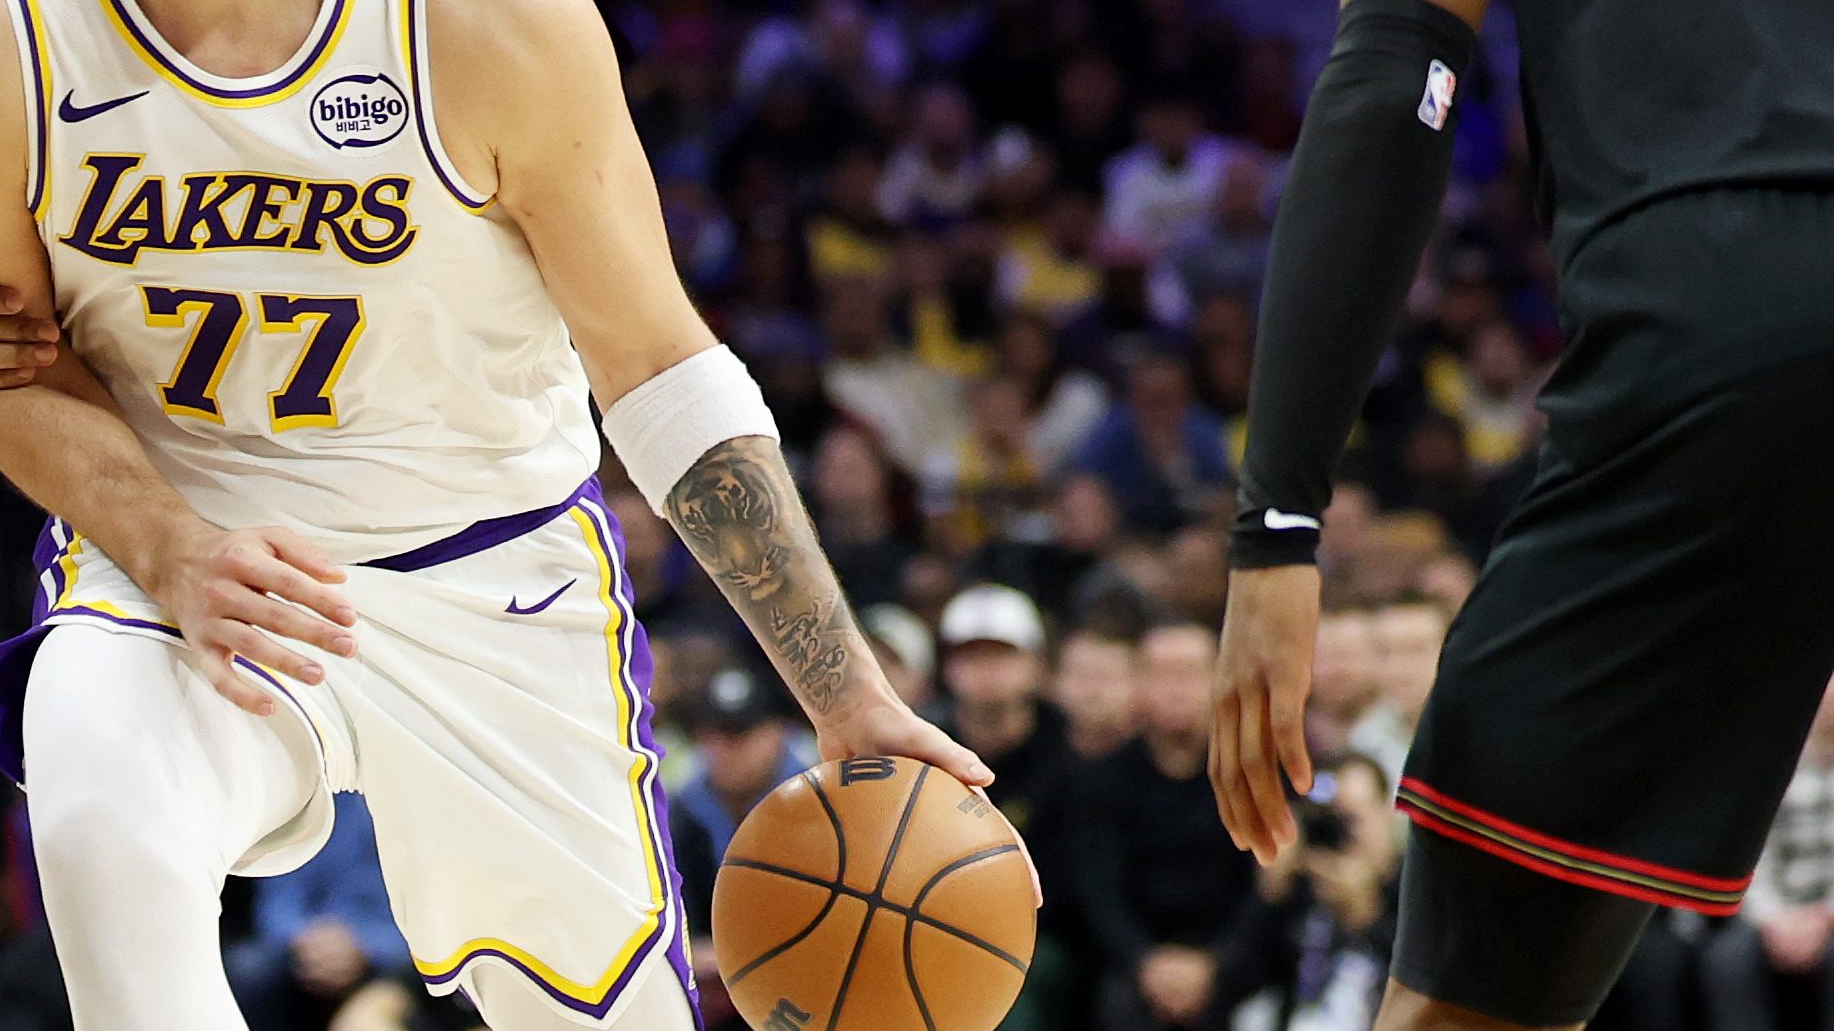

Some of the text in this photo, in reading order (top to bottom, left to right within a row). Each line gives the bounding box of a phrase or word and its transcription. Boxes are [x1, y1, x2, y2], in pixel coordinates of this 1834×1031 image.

[319, 94, 403, 124] bibigo
[335, 119, 372, 133] 비비고
[56, 152, 422, 268] LAKERS
[136, 284, 367, 434] 77
